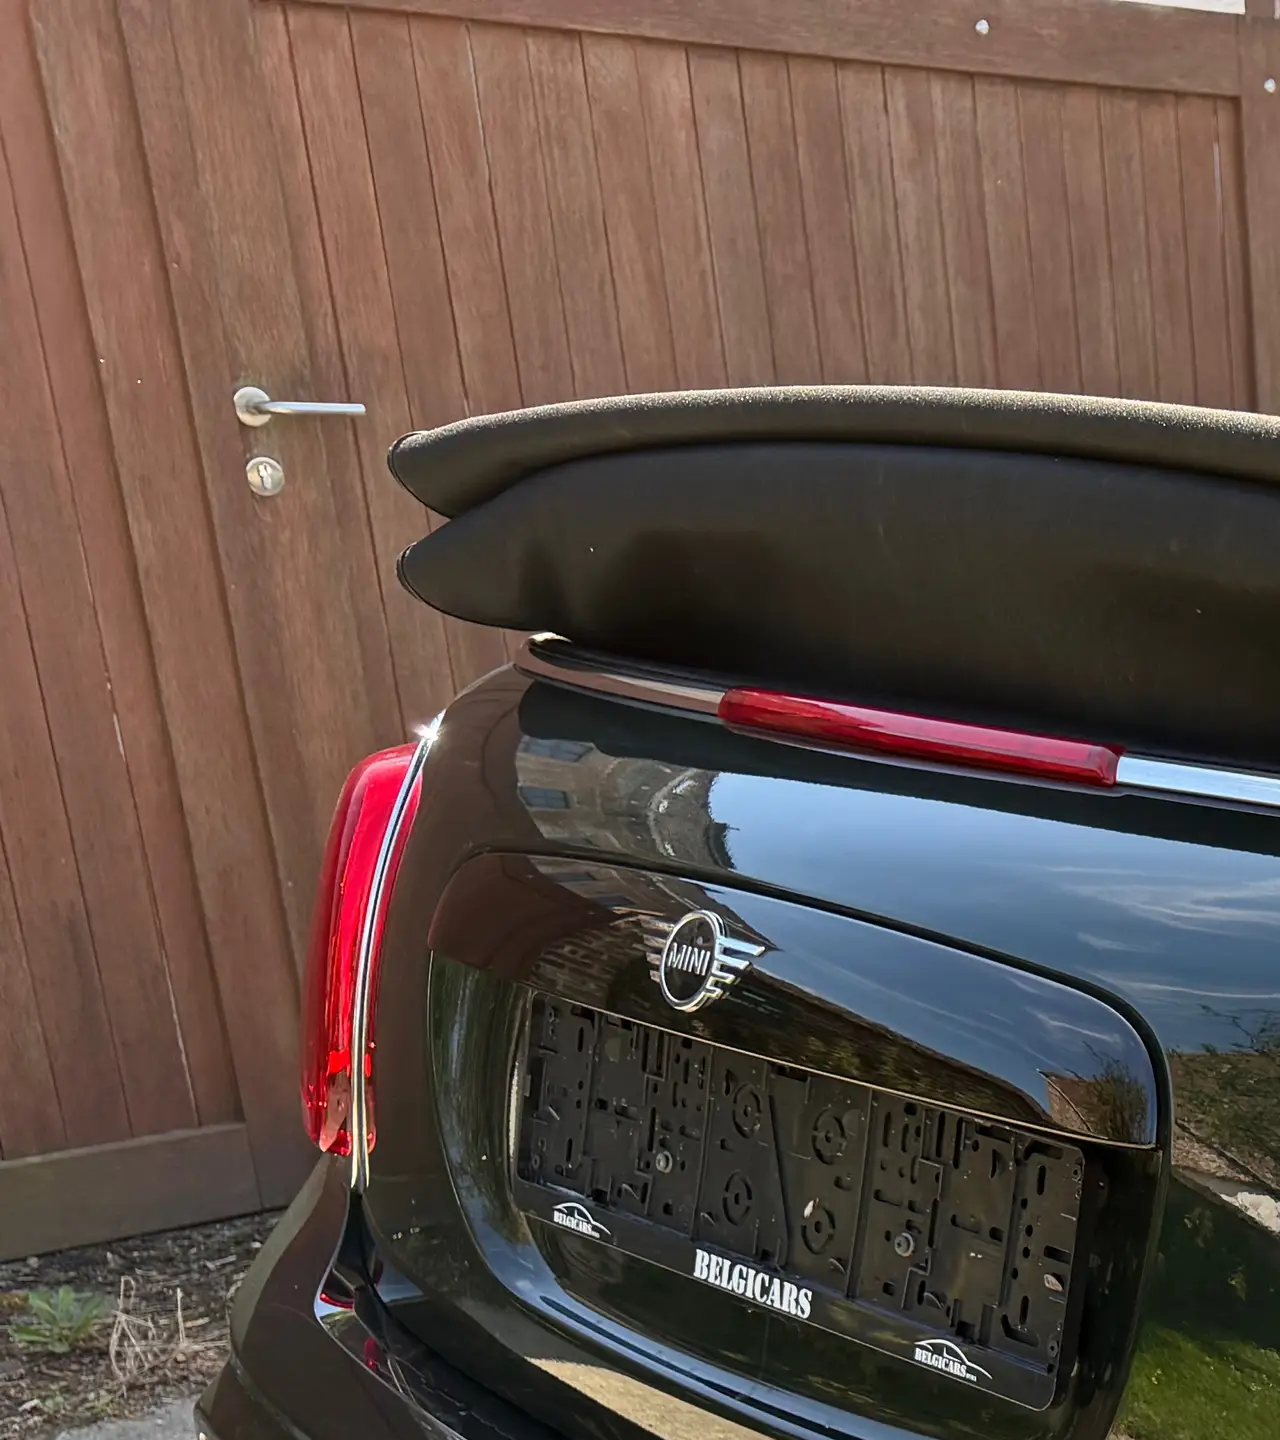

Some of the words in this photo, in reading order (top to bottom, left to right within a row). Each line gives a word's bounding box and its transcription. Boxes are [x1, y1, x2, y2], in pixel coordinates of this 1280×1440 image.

[668, 942, 711, 976] MINI
[693, 1248, 813, 1319] BELGICARS
[914, 1347, 967, 1379] BELGICARS
